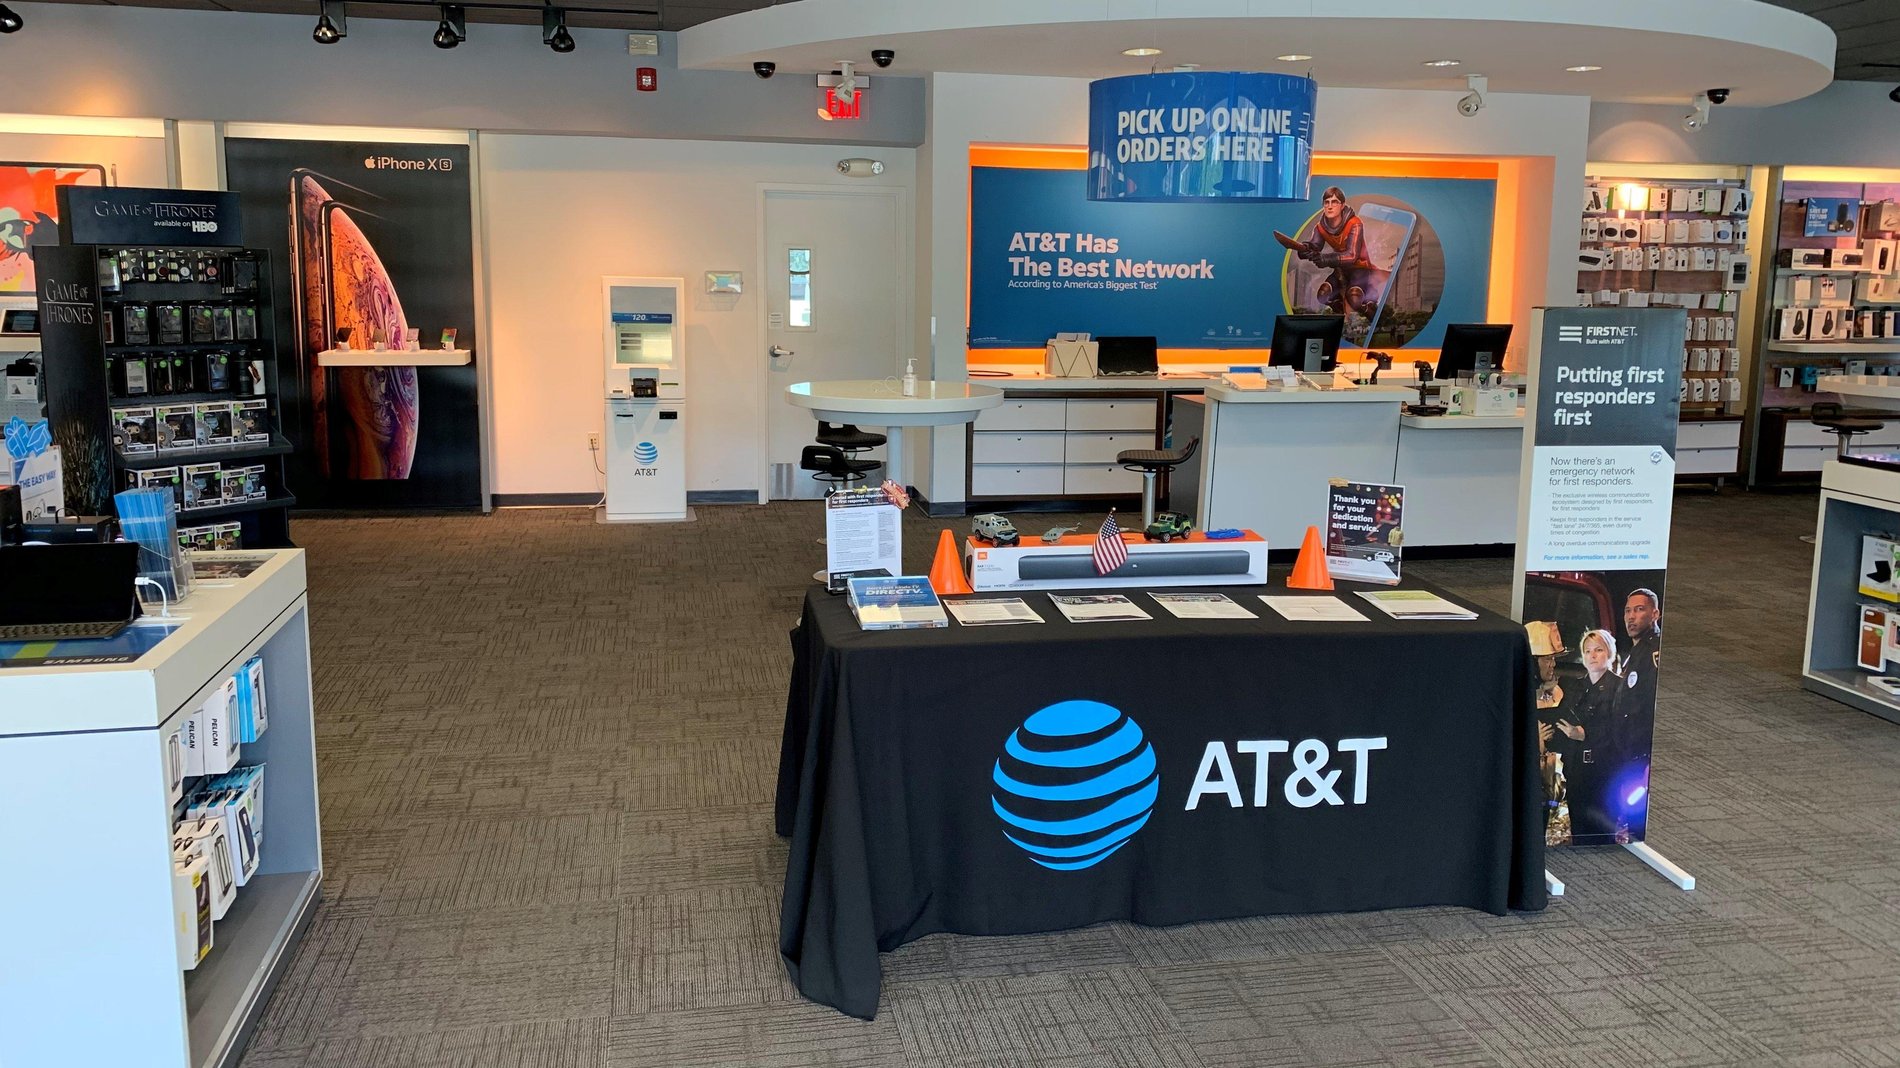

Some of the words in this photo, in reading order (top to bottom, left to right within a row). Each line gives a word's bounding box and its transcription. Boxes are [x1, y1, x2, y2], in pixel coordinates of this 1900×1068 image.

[1117, 108, 1166, 136] PICK
[1172, 107, 1206, 134] UP
[1212, 107, 1292, 135] ONLINE
[1116, 135, 1206, 164] ORDERS
[1218, 135, 1274, 163] HERE
[377, 156, 425, 170] iPhone
[94, 200, 141, 218] GAME
[150, 202, 217, 219] THRONES
[154, 220, 182, 228] available
[192, 220, 218, 233] HBO
[1008, 231, 1071, 253] AT&T
[1076, 233, 1119, 254] Has
[1008, 256, 1051, 277] The
[1058, 257, 1110, 278] Best
[1115, 258, 1215, 280] Network
[44, 278, 80, 301] GAME
[1008, 279, 1050, 291] According
[1052, 280, 1062, 289] to
[1064, 280, 1104, 290] America's
[1106, 280, 1138, 292] Biggest
[43, 301, 95, 326] THRONES
[1556, 366, 1624, 386] Putting
[1627, 366, 1665, 383] first
[1555, 388, 1656, 408] responders
[1554, 408, 1592, 426] first
[1550, 457, 1572, 466] Now
[1573, 456, 1602, 466] there's
[634, 468, 658, 476] AT&T
[1550, 468, 1598, 477] emergency
[1601, 467, 1635, 475] network
[31, 473, 45, 486] EASY
[1549, 477, 1560, 486] for
[1564, 477, 1580, 485] first
[1582, 476, 1633, 487] responders.
[1333, 494, 1358, 504] Thank
[1332, 513, 1373, 523] dedication
[1348, 524, 1379, 532] service.
[42, 656, 129, 665] SAMSUNG
[1184, 737, 1388, 811] AT&T
